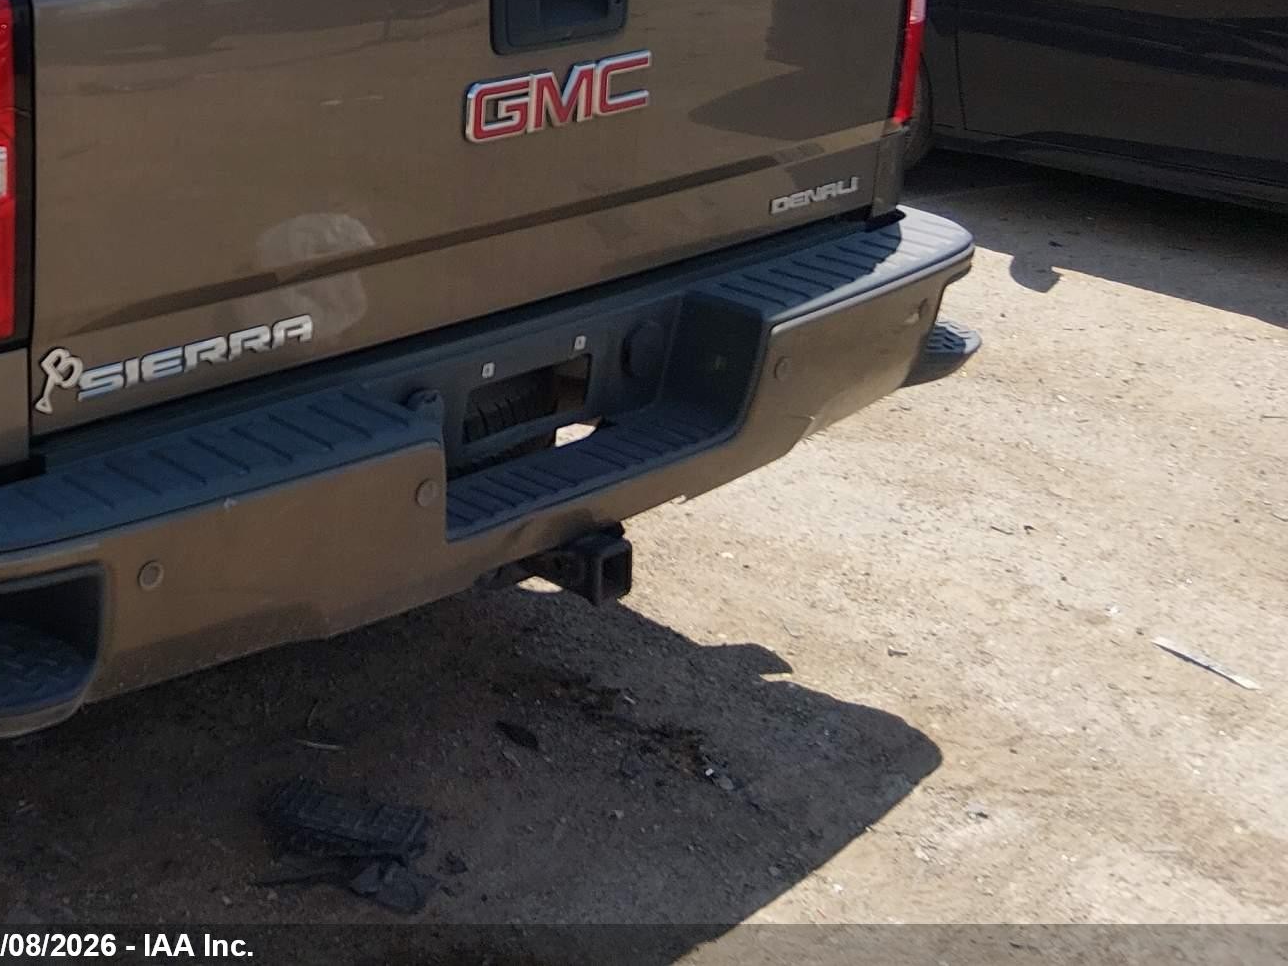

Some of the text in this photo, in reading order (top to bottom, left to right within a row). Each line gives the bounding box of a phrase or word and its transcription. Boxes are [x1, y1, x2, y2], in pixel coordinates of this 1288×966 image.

[465, 49, 652, 143] GMC
[770, 176, 859, 215] DENALI
[77, 313, 313, 402] SIERRA
